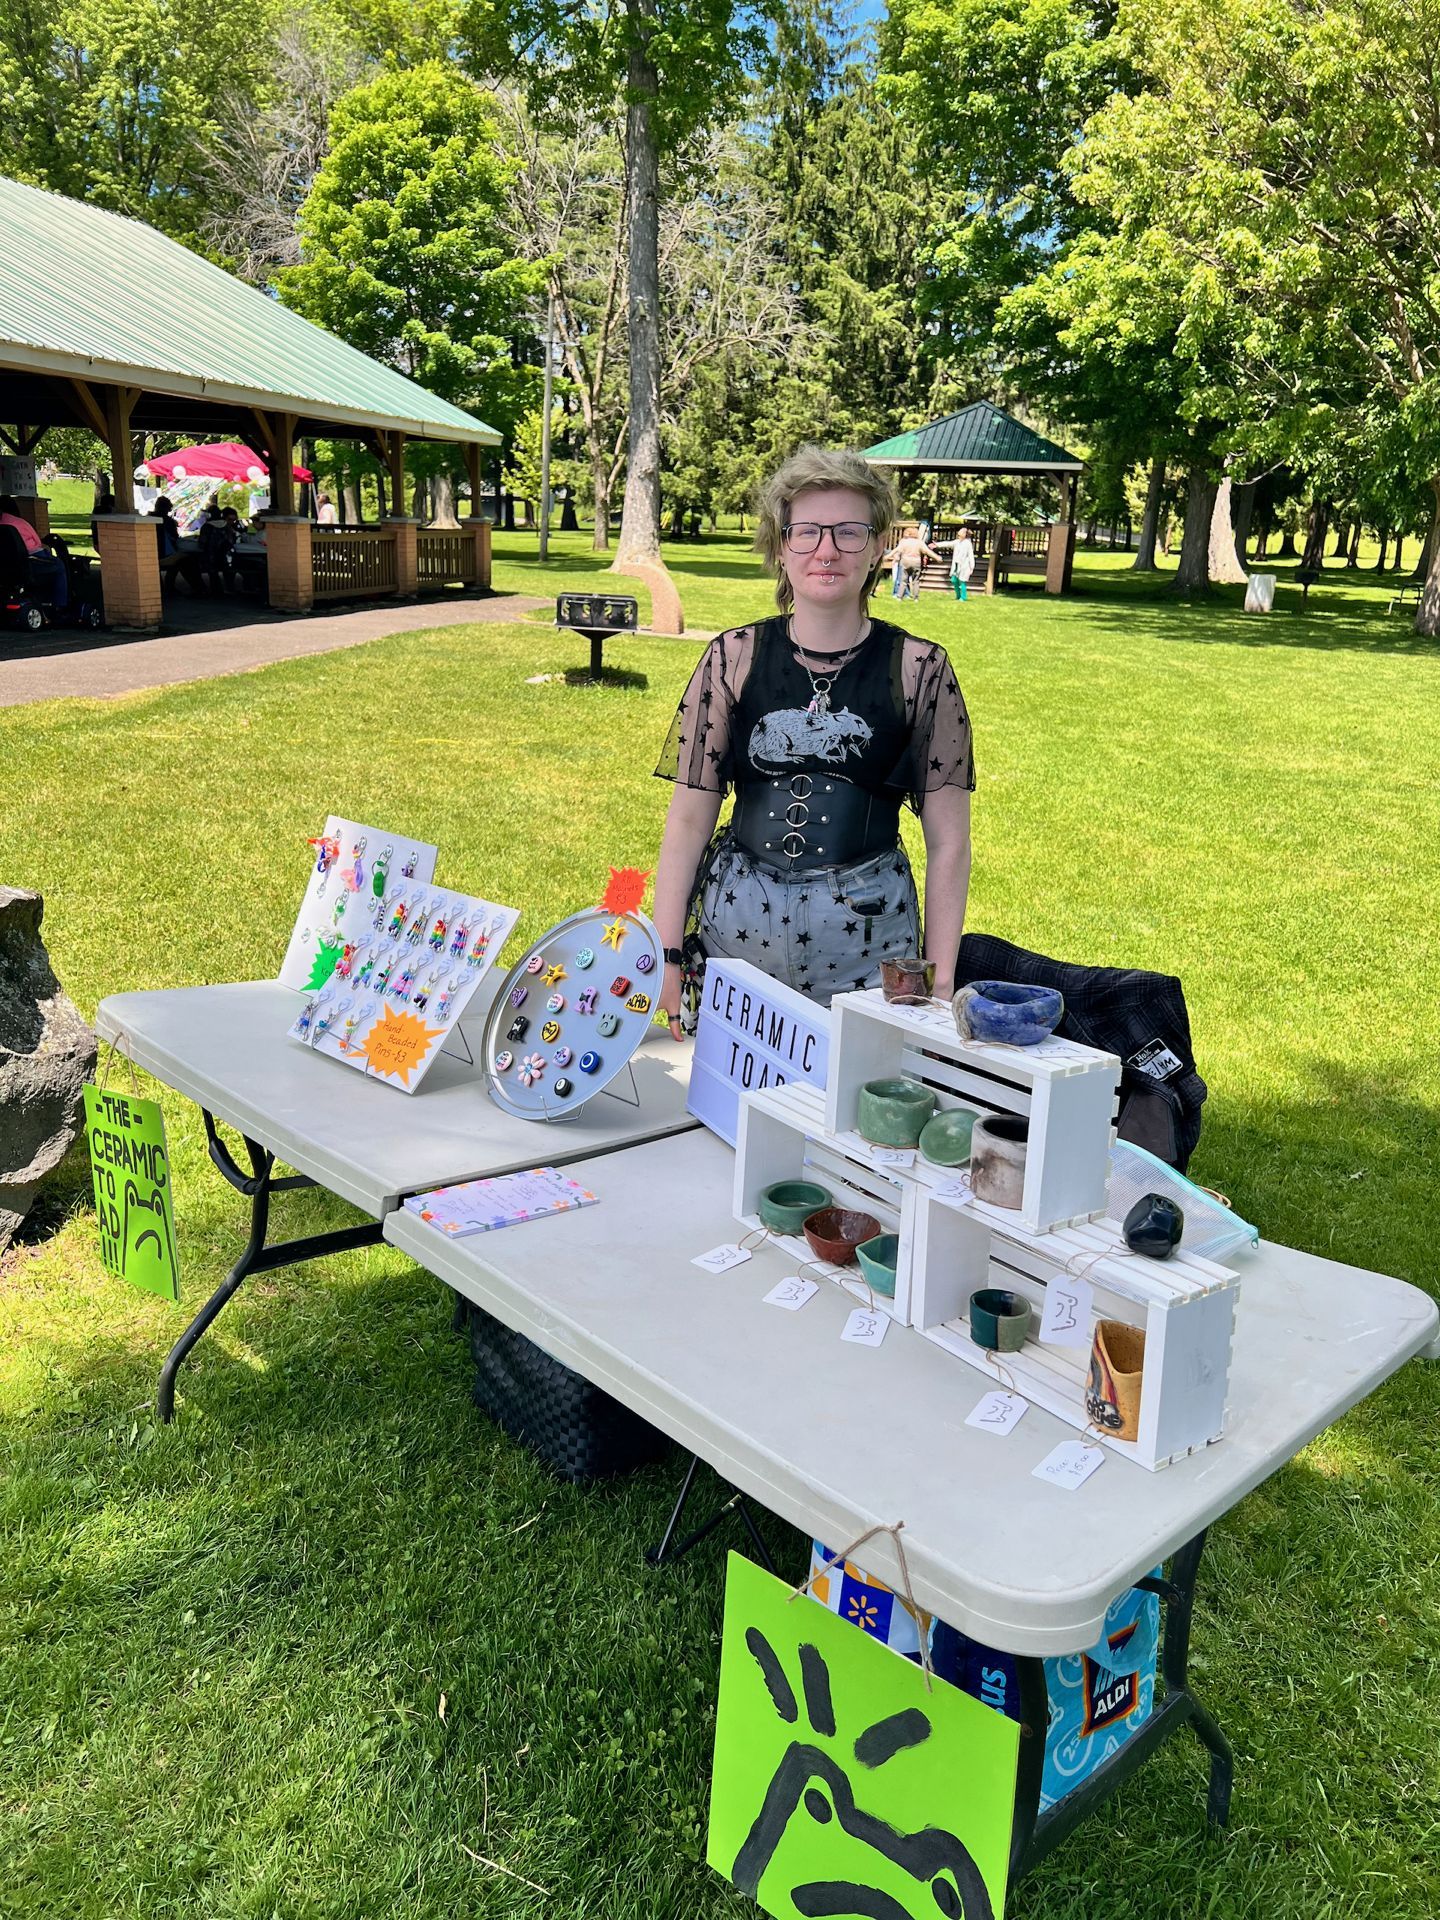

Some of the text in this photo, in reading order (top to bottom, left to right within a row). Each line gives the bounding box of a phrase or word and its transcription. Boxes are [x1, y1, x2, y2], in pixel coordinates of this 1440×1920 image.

[712, 976, 816, 1072] CERAMIC
[92, 1127, 167, 1188] CERAMIC
[94, 1169, 115, 1200] TO
[1094, 1678, 1130, 1719] ALDI
